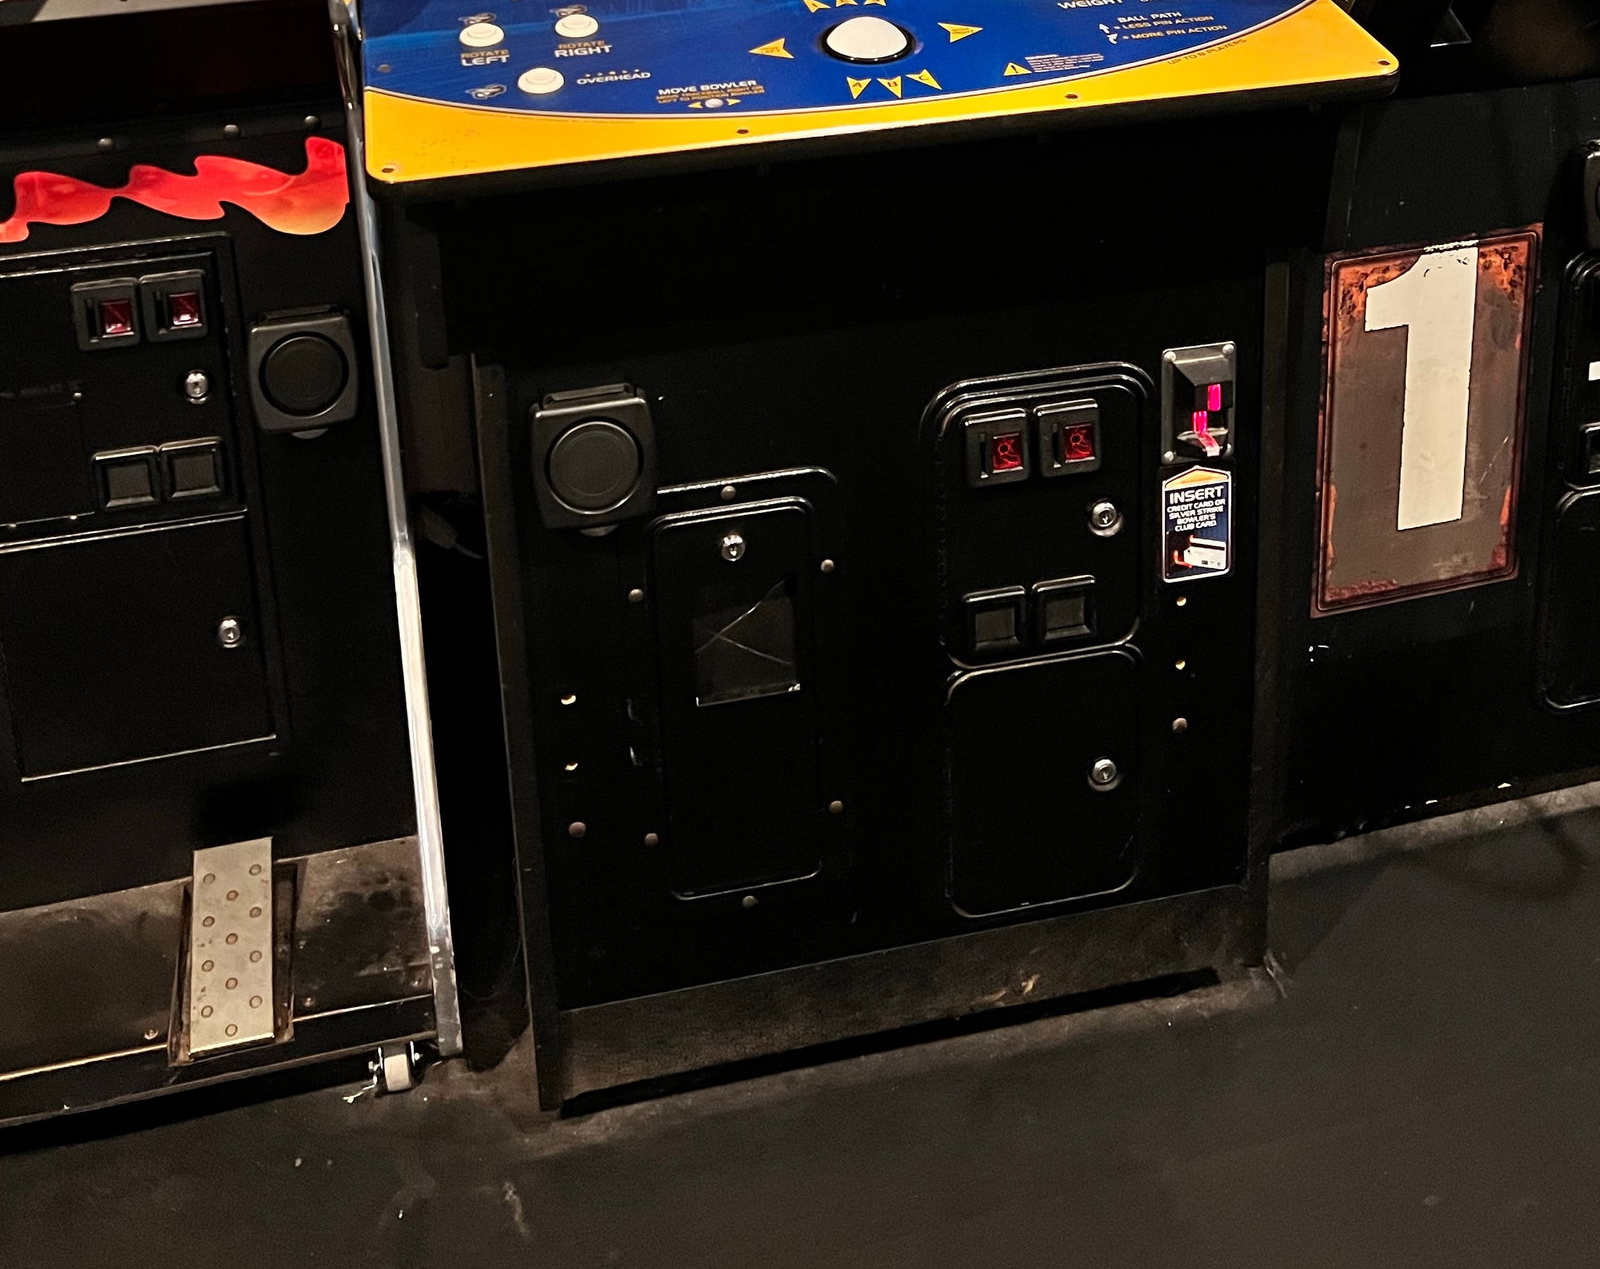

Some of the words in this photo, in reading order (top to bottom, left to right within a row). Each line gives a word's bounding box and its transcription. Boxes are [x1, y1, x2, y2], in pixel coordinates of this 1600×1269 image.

[1117, 15, 1148, 23] BALL
[1151, 11, 1182, 20] PATH
[1122, 21, 1151, 30] LESS
[1175, 15, 1215, 24] ACTION
[1131, 31, 1164, 40] MORE
[1188, 24, 1227, 34] ACTION
[554, 45, 612, 57] RIGHT
[558, 41, 605, 49] ROTATE
[460, 50, 509, 59] ROTATE
[461, 55, 510, 66] LEFT
[577, 71, 650, 85] OVERHEAD
[658, 86, 697, 95] MOVE
[700, 80, 757, 91] BOWLER
[1365, 239, 1479, 531] 1
[1169, 486, 1224, 505] INSERT
[1167, 503, 1193, 513] CREDIT
[1194, 500, 1214, 509] CARD
[1169, 510, 1196, 520] SILVER
[1197, 505, 1224, 515] STRIKE
[1175, 524, 1195, 532] CLUB
[1196, 520, 1217, 528] CARD
